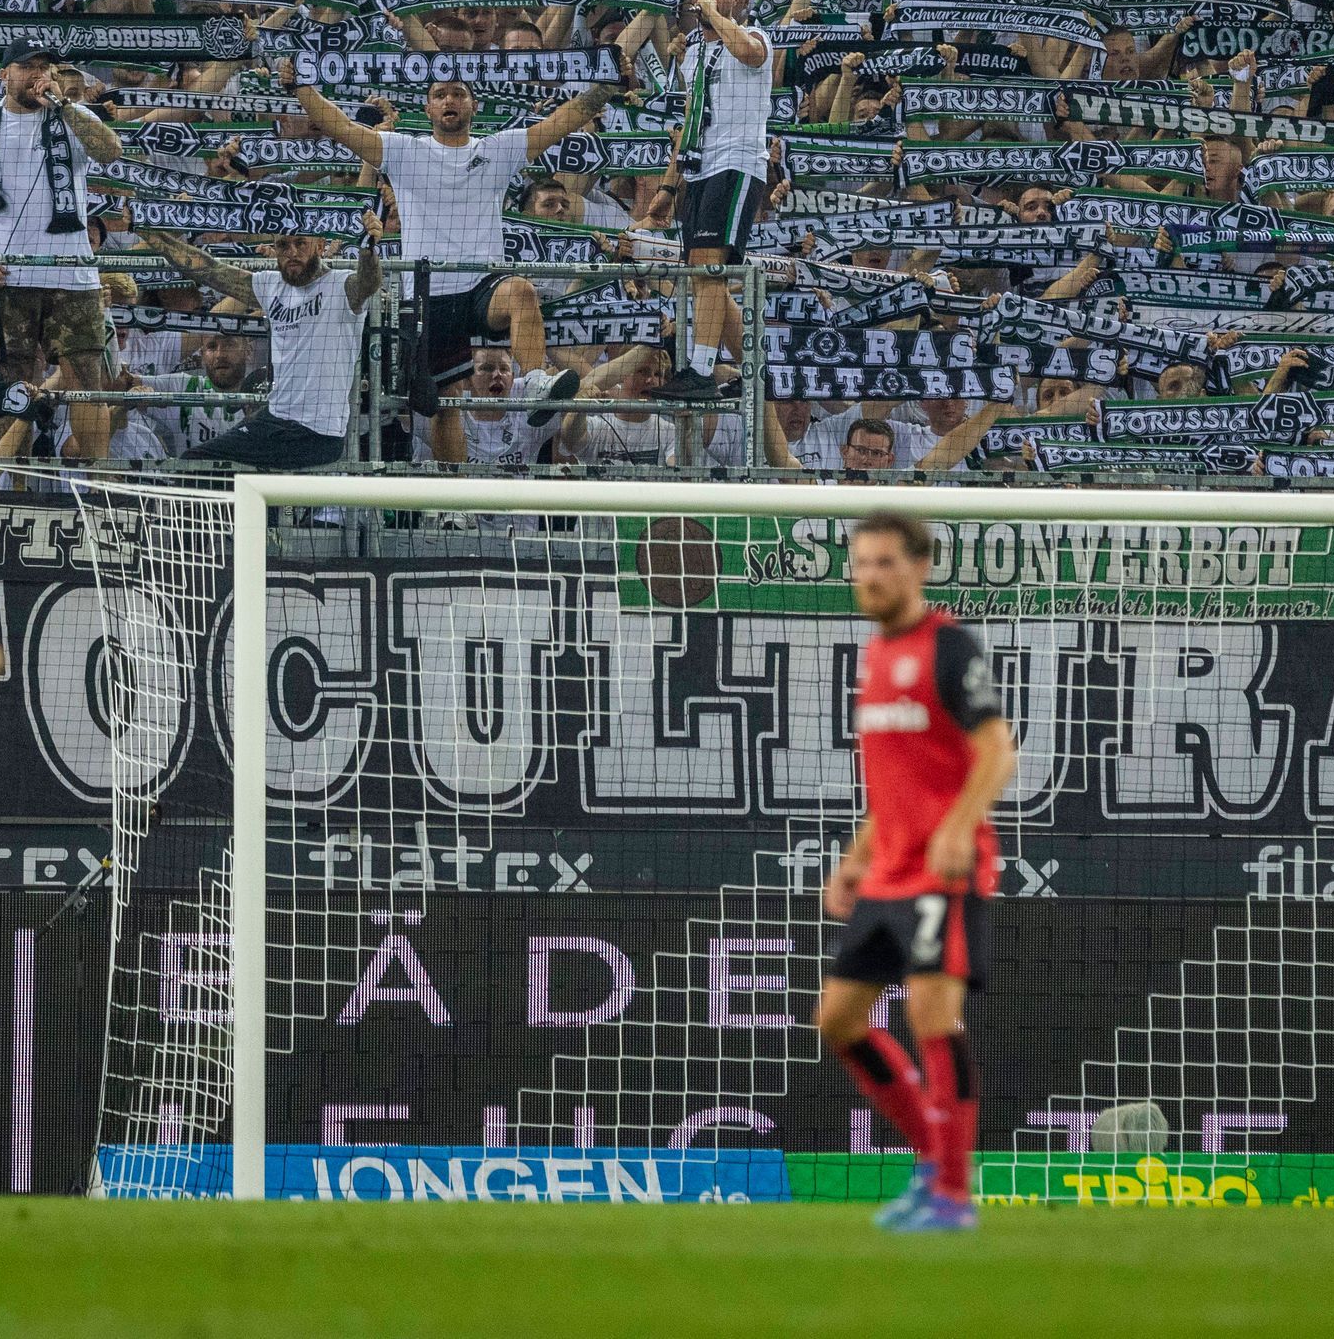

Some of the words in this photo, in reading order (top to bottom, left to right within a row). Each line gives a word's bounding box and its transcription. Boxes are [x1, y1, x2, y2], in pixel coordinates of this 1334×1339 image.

[900, 9, 958, 23] Schwarz
[961, 10, 983, 23] und
[991, 11, 1025, 27] Weiß
[1027, 16, 1049, 28] ein
[60, 24, 95, 57] für
[95, 28, 201, 50] BORUSSIA
[294, 46, 622, 84] SOTTOCULTURA
[905, 86, 1040, 113] BORUSSIA
[904, 148, 1052, 175] BORUSSIA
[1132, 147, 1204, 172] FANS
[88, 161, 229, 201] BORUSSIA
[133, 201, 243, 230] BORUSSIA
[304, 205, 365, 234] FANS
[1066, 198, 1209, 226] BORUSSIA
[104, 257, 157, 266] SOTTOCULTURA
[863, 332, 975, 368] RAS
[772, 367, 863, 400] ULT
[1108, 407, 1247, 435] BORUSSIA
[1043, 590, 1146, 617] verbindet
[1152, 599, 1193, 617] uns
[1196, 597, 1238, 625] für
[309, 834, 593, 893] flatex
[910, 894, 948, 945] 7
[290, 1157, 664, 1205] JONGEN
